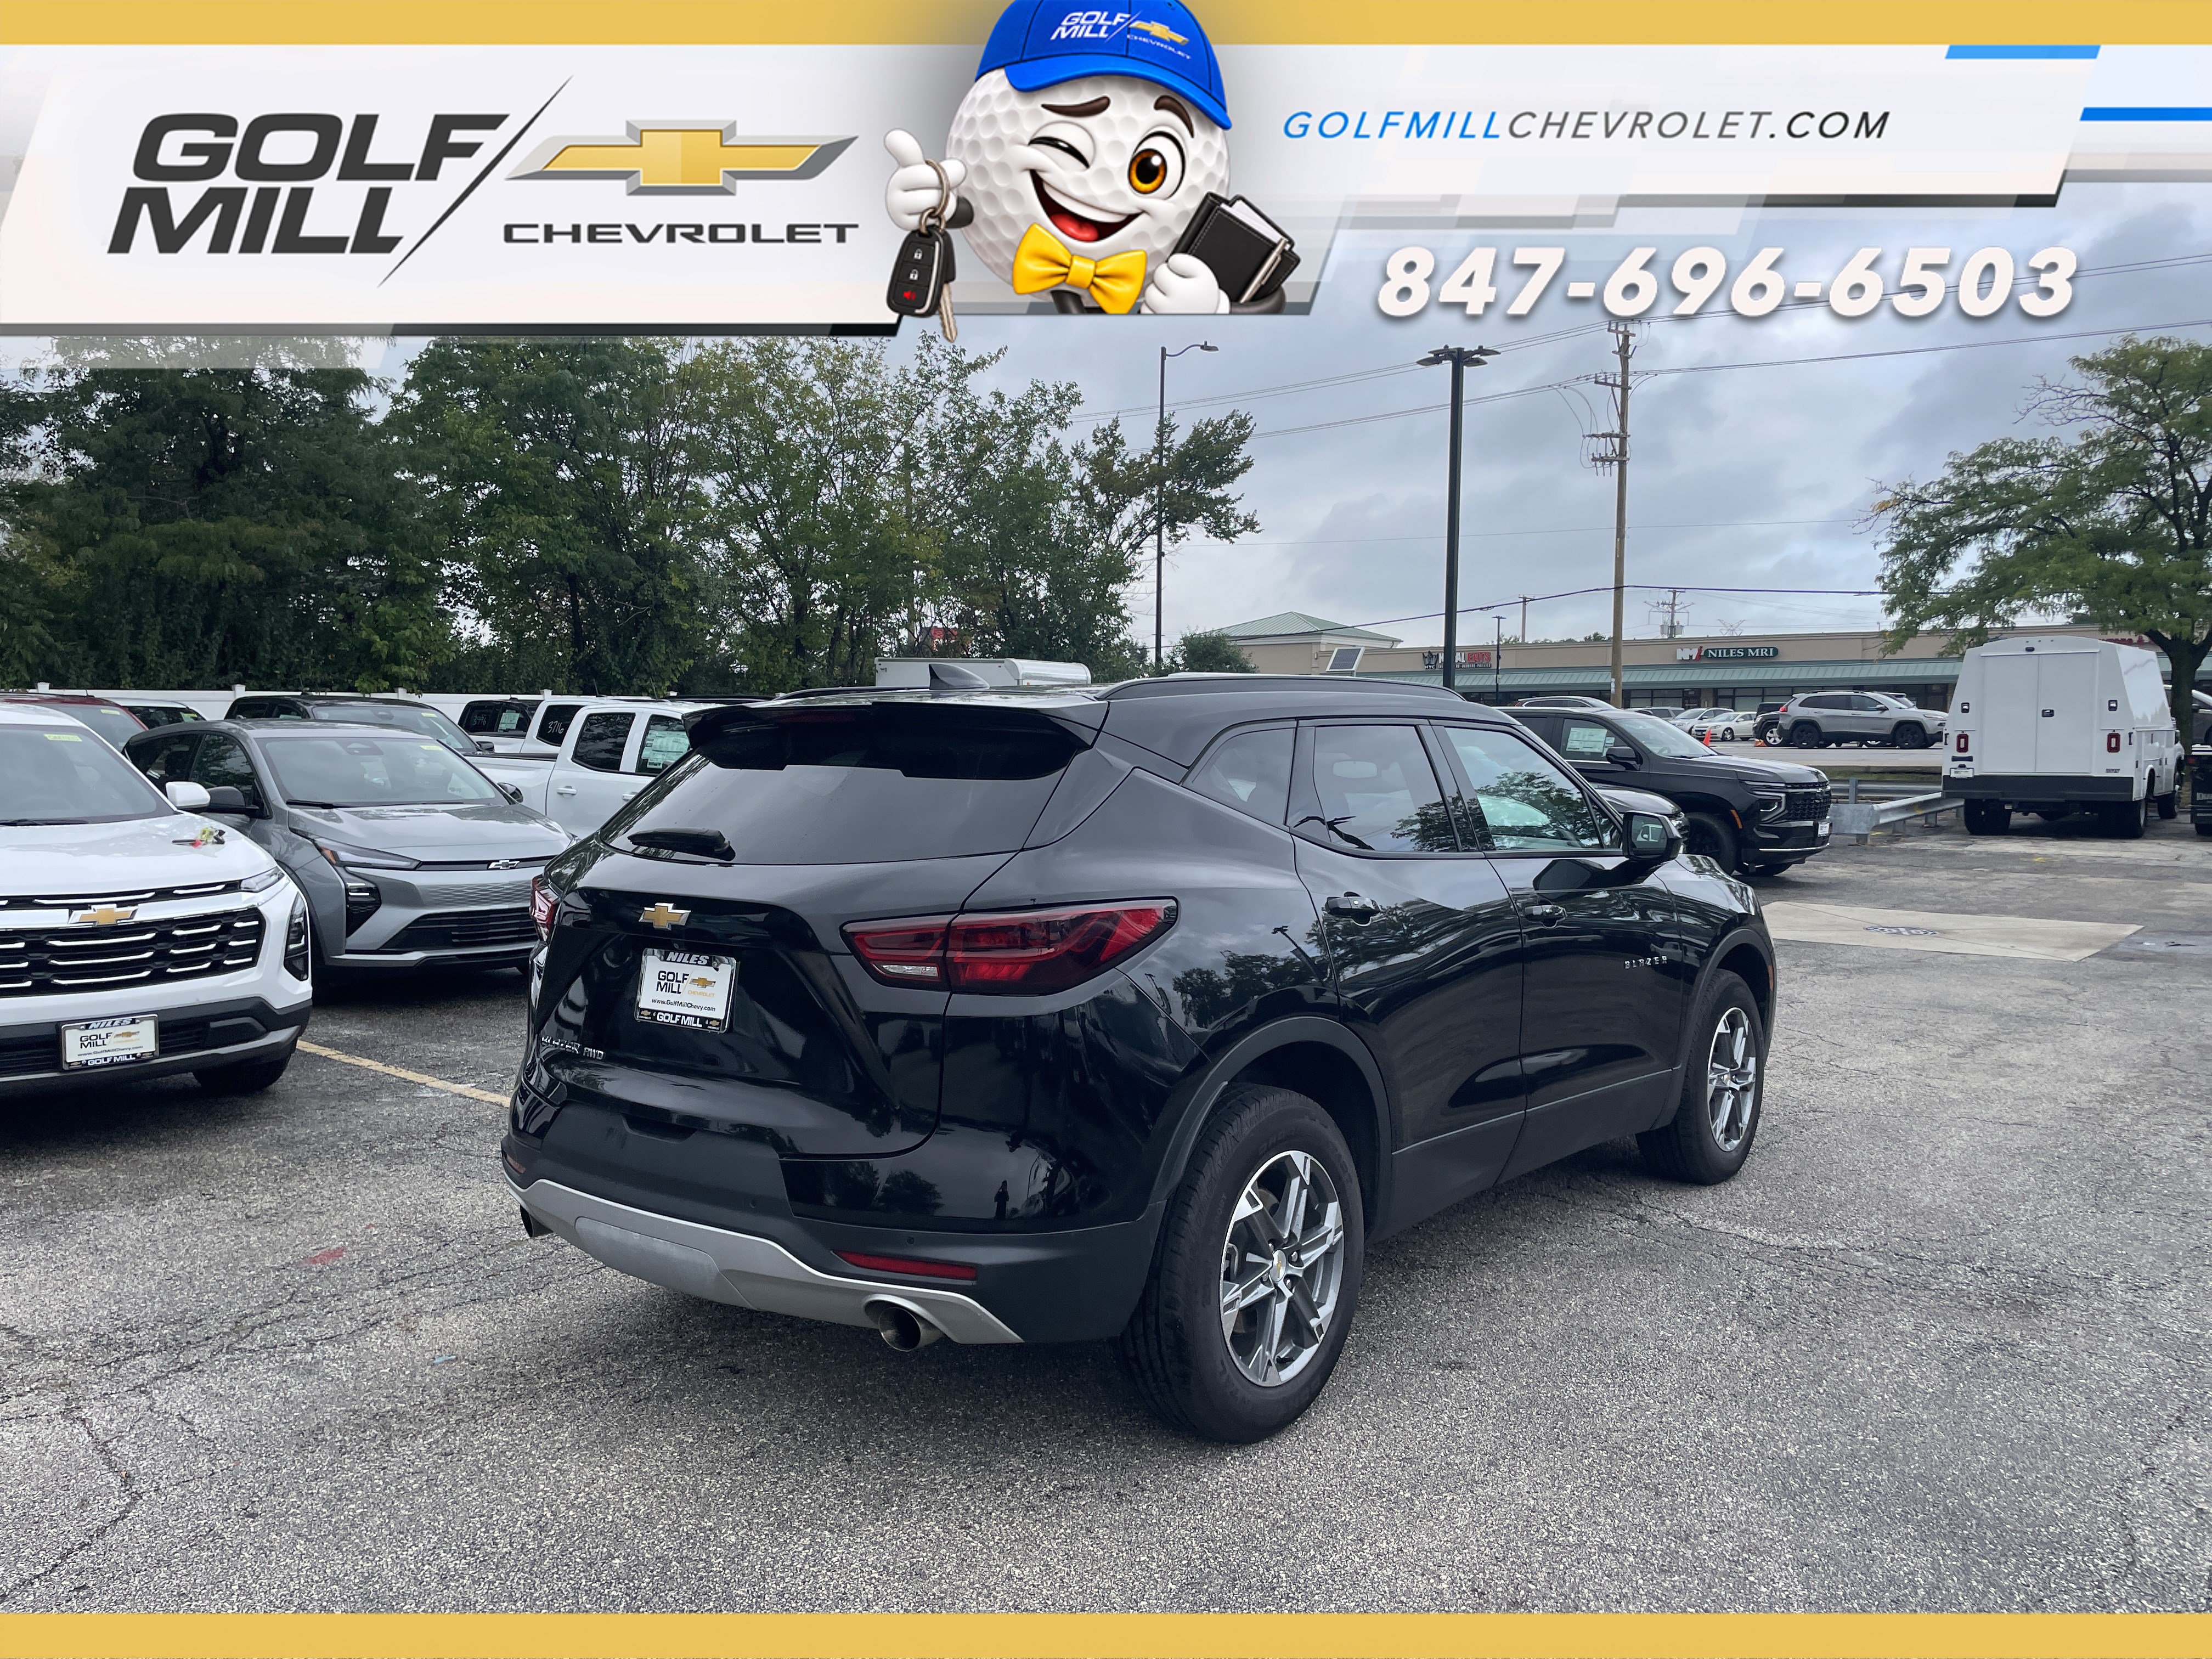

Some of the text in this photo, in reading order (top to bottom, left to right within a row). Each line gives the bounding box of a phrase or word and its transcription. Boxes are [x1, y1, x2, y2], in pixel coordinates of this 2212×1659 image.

[1438, 652, 1491, 663] HAL EATS
[1708, 648, 1774, 658] NILES MRI
[548, 720, 564, 734] 3716
[666, 951, 709, 965] NILES
[1624, 956, 1667, 969] BLAZER
[658, 970, 690, 984] GOLF
[656, 981, 681, 994] MILL
[652, 998, 716, 1012] www.GolfMillChevy.com
[88, 1018, 133, 1030] NILES
[657, 1012, 681, 1024] GOLF
[681, 1016, 702, 1028] MILL
[80, 1032, 112, 1042] GOLF
[80, 1040, 107, 1049] MILL
[88, 1057, 112, 1066] GOLF
[113, 1054, 136, 1063] MILL
